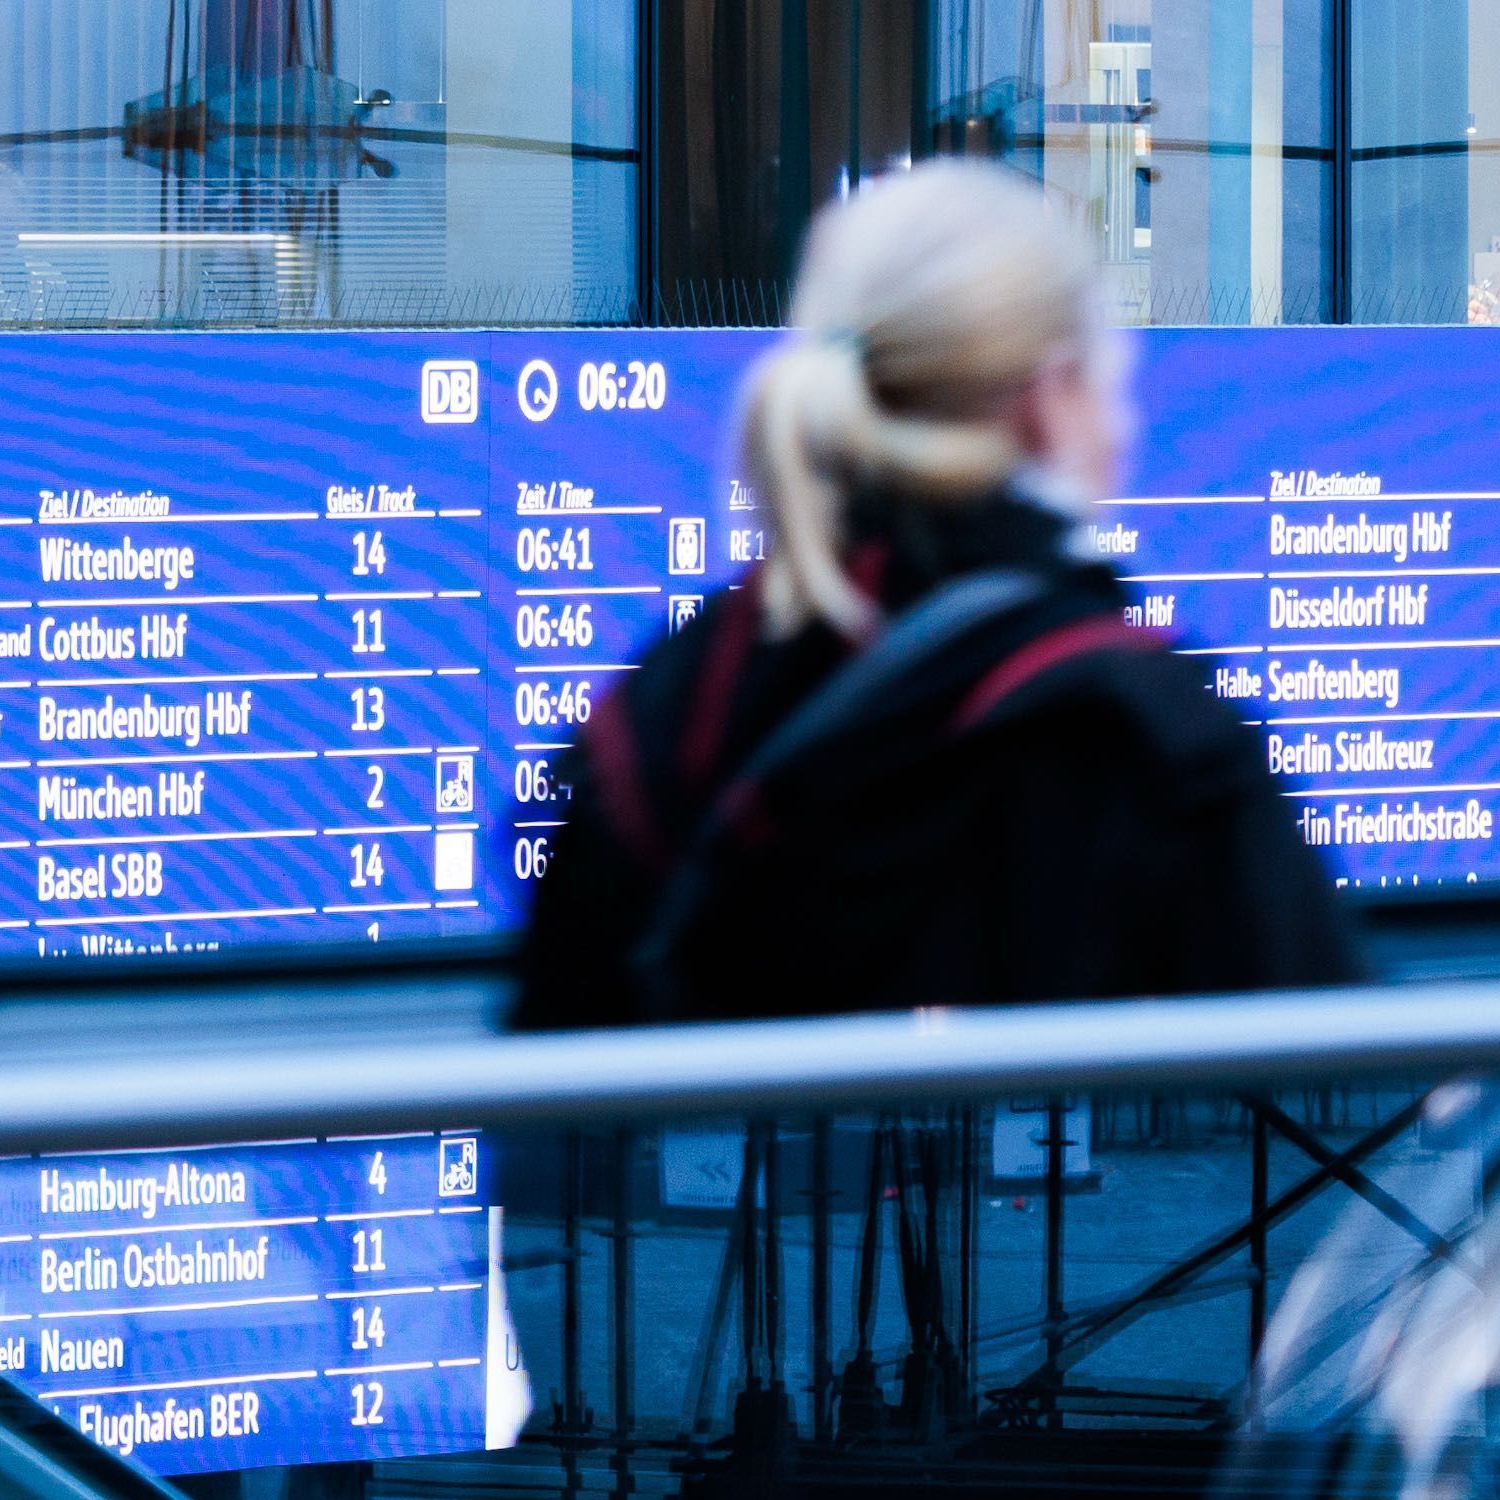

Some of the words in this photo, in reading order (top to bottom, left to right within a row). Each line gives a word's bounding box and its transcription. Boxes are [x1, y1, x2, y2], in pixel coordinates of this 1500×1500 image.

[427, 371, 472, 414] DB
[578, 360, 666, 411] 06:20
[352, 530, 387, 576] 14
[516, 527, 594, 572] 06:41
[1270, 512, 1408, 563] Brandenburg
[1411, 510, 1453, 553] Hbf
[39, 535, 195, 591] Wittenberge
[516, 602, 593, 648] 06:46
[1269, 586, 1386, 629] Düsseldorf
[1388, 583, 1429, 626] Hbf
[38, 616, 136, 662] Cottbus
[141, 613, 188, 659] Hbf
[351, 609, 386, 653] 11
[515, 680, 591, 726] 06:46
[1267, 658, 1399, 709] Senftenberg
[39, 693, 201, 748] Brandenburg
[206, 690, 252, 736] Hbf
[350, 686, 385, 732] 13
[1268, 732, 1332, 774] Berlin
[1335, 730, 1434, 773] Südkreuz
[38, 774, 153, 821] München
[158, 770, 205, 817] Hbf
[366, 765, 384, 809] 2
[1334, 798, 1493, 845] Friedrichstraße
[38, 854, 107, 902] Basel
[111, 851, 163, 898] SBB
[350, 842, 385, 888] 14
[40, 1162, 246, 1220] Hamburg-Altona
[368, 1151, 388, 1195] 4
[40, 1246, 118, 1294] Berlin
[123, 1235, 269, 1288] Ostbahnhof
[352, 1228, 387, 1273] 11
[40, 1328, 124, 1373] Nauen
[351, 1305, 386, 1350] 14
[210, 1391, 260, 1438] BER
[351, 1380, 384, 1426] 12
